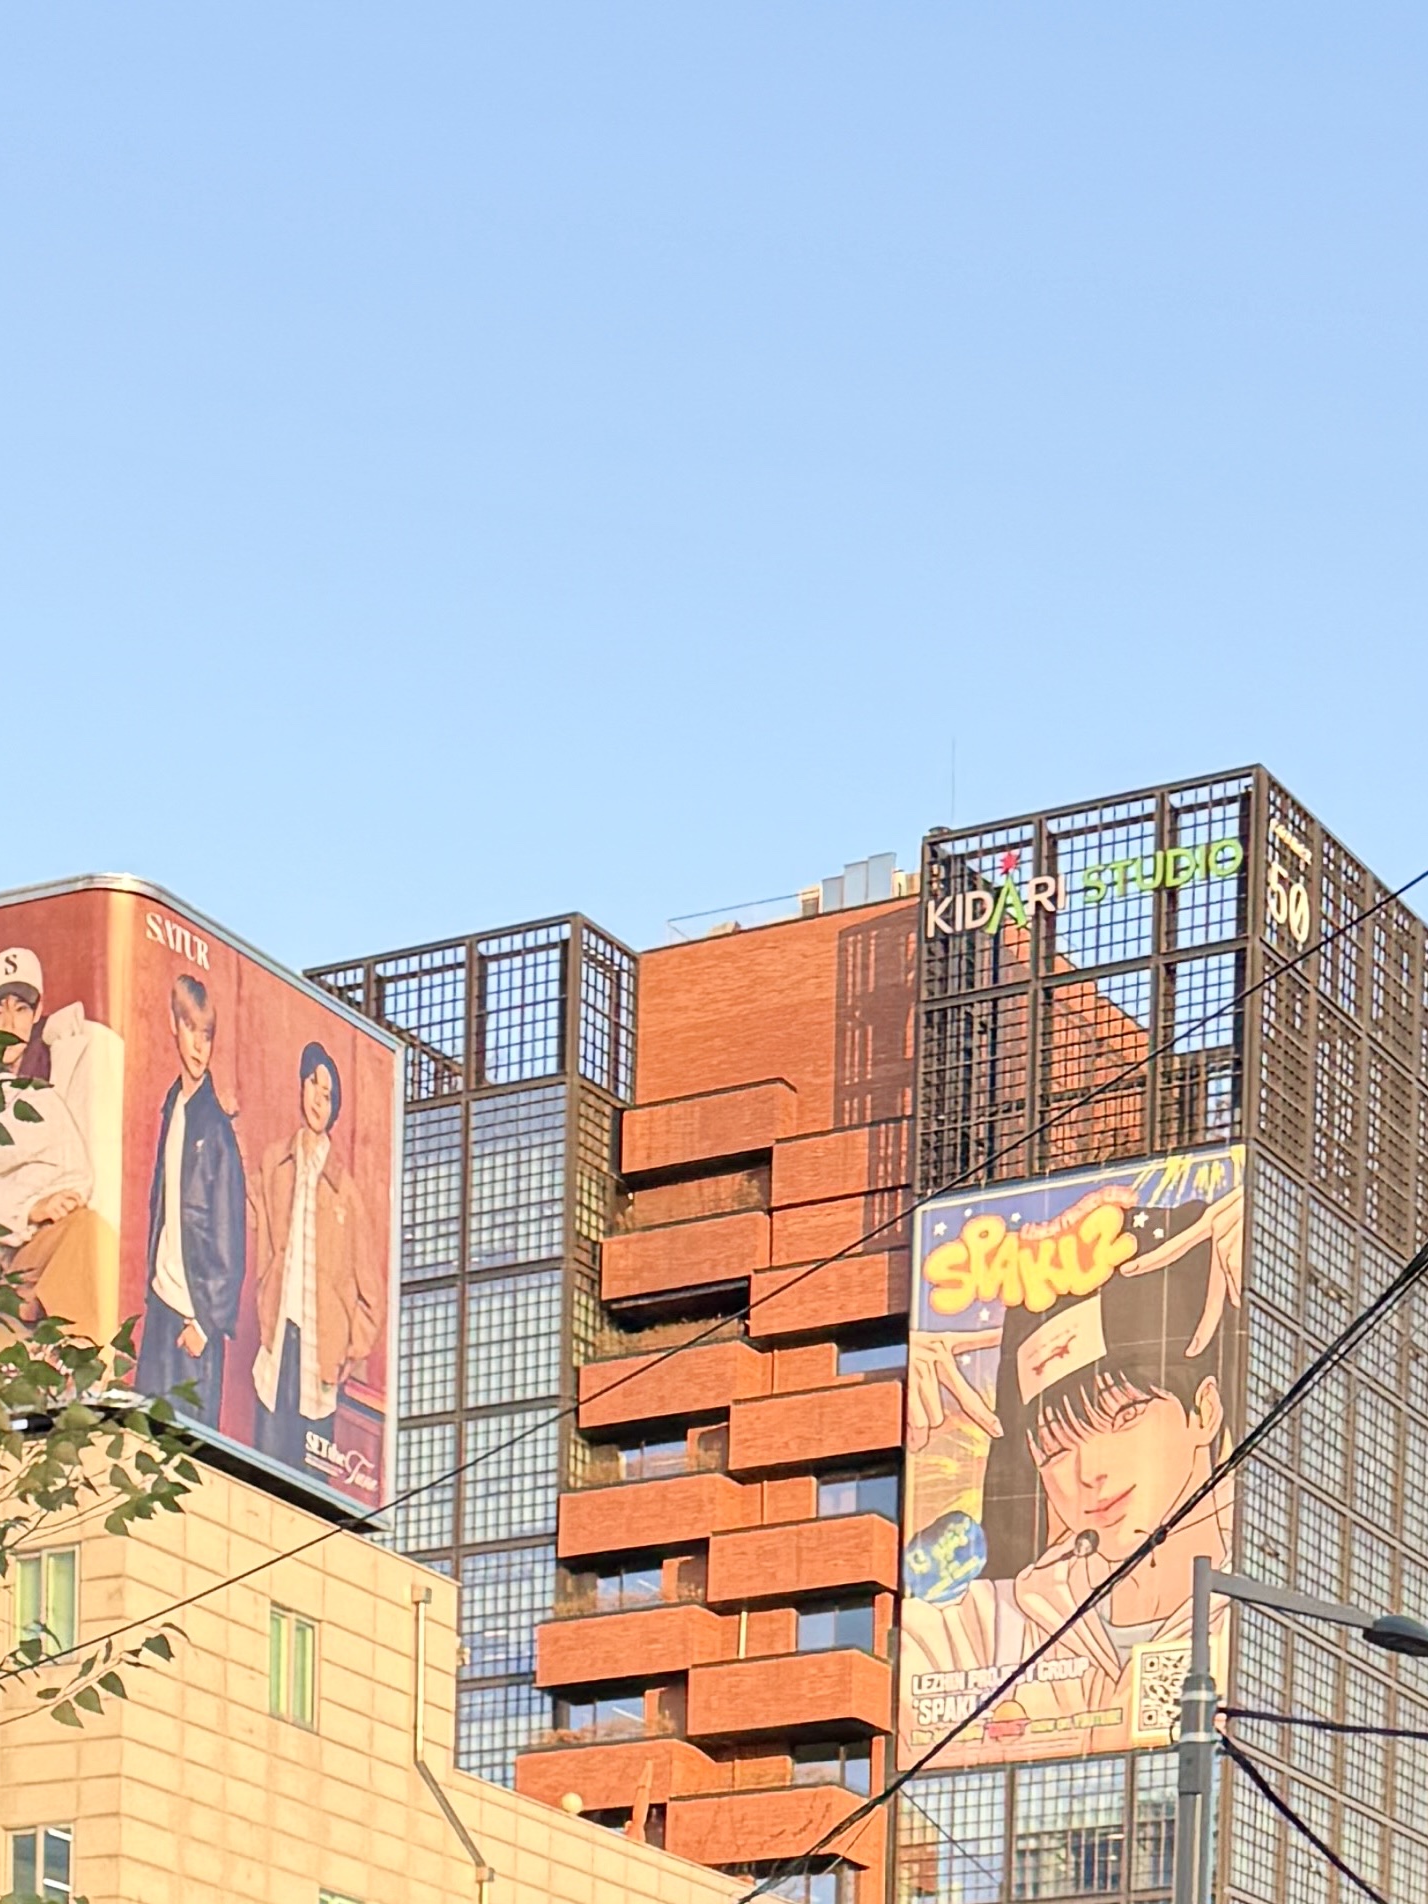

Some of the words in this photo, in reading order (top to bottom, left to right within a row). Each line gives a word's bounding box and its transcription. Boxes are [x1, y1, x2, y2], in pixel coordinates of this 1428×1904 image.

[926, 874, 1067, 939] KIDARI
[1082, 838, 1244, 903] STUDIO
[146, 911, 210, 971] SATUR
[4, 954, 18, 976] S
[1037, 1656, 1090, 1682] GROUP
